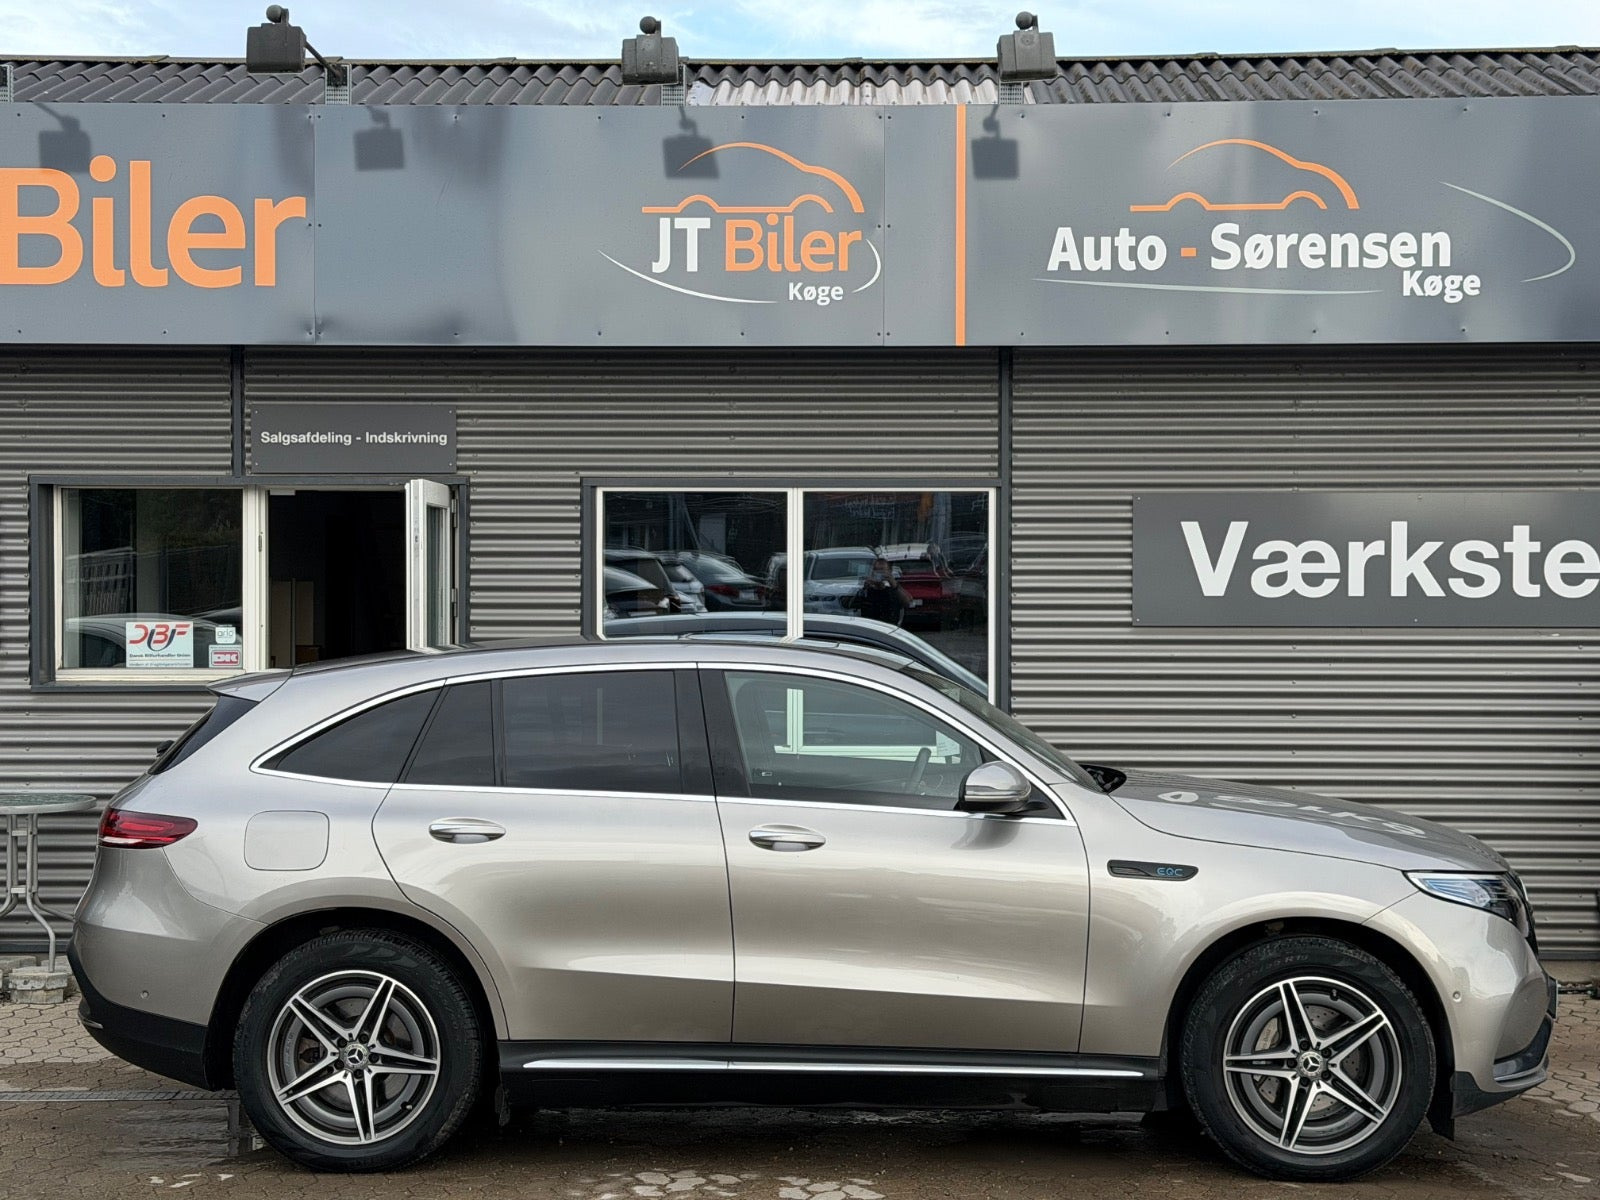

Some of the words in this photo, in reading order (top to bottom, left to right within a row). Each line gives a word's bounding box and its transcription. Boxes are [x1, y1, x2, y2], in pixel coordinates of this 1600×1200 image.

[0, 155, 307, 288] Biler
[651, 217, 711, 273] JT
[725, 213, 862, 272] Biler
[1047, 227, 1167, 271] Auto
[1210, 223, 1451, 270] Sørensen
[788, 282, 844, 306] Køge
[1402, 270, 1481, 303] Køge
[260, 431, 352, 446] Salgsafdeling
[365, 431, 448, 446] Indskrivning
[1180, 520, 1600, 599] Værkste
[1156, 867, 1184, 877] EQC
